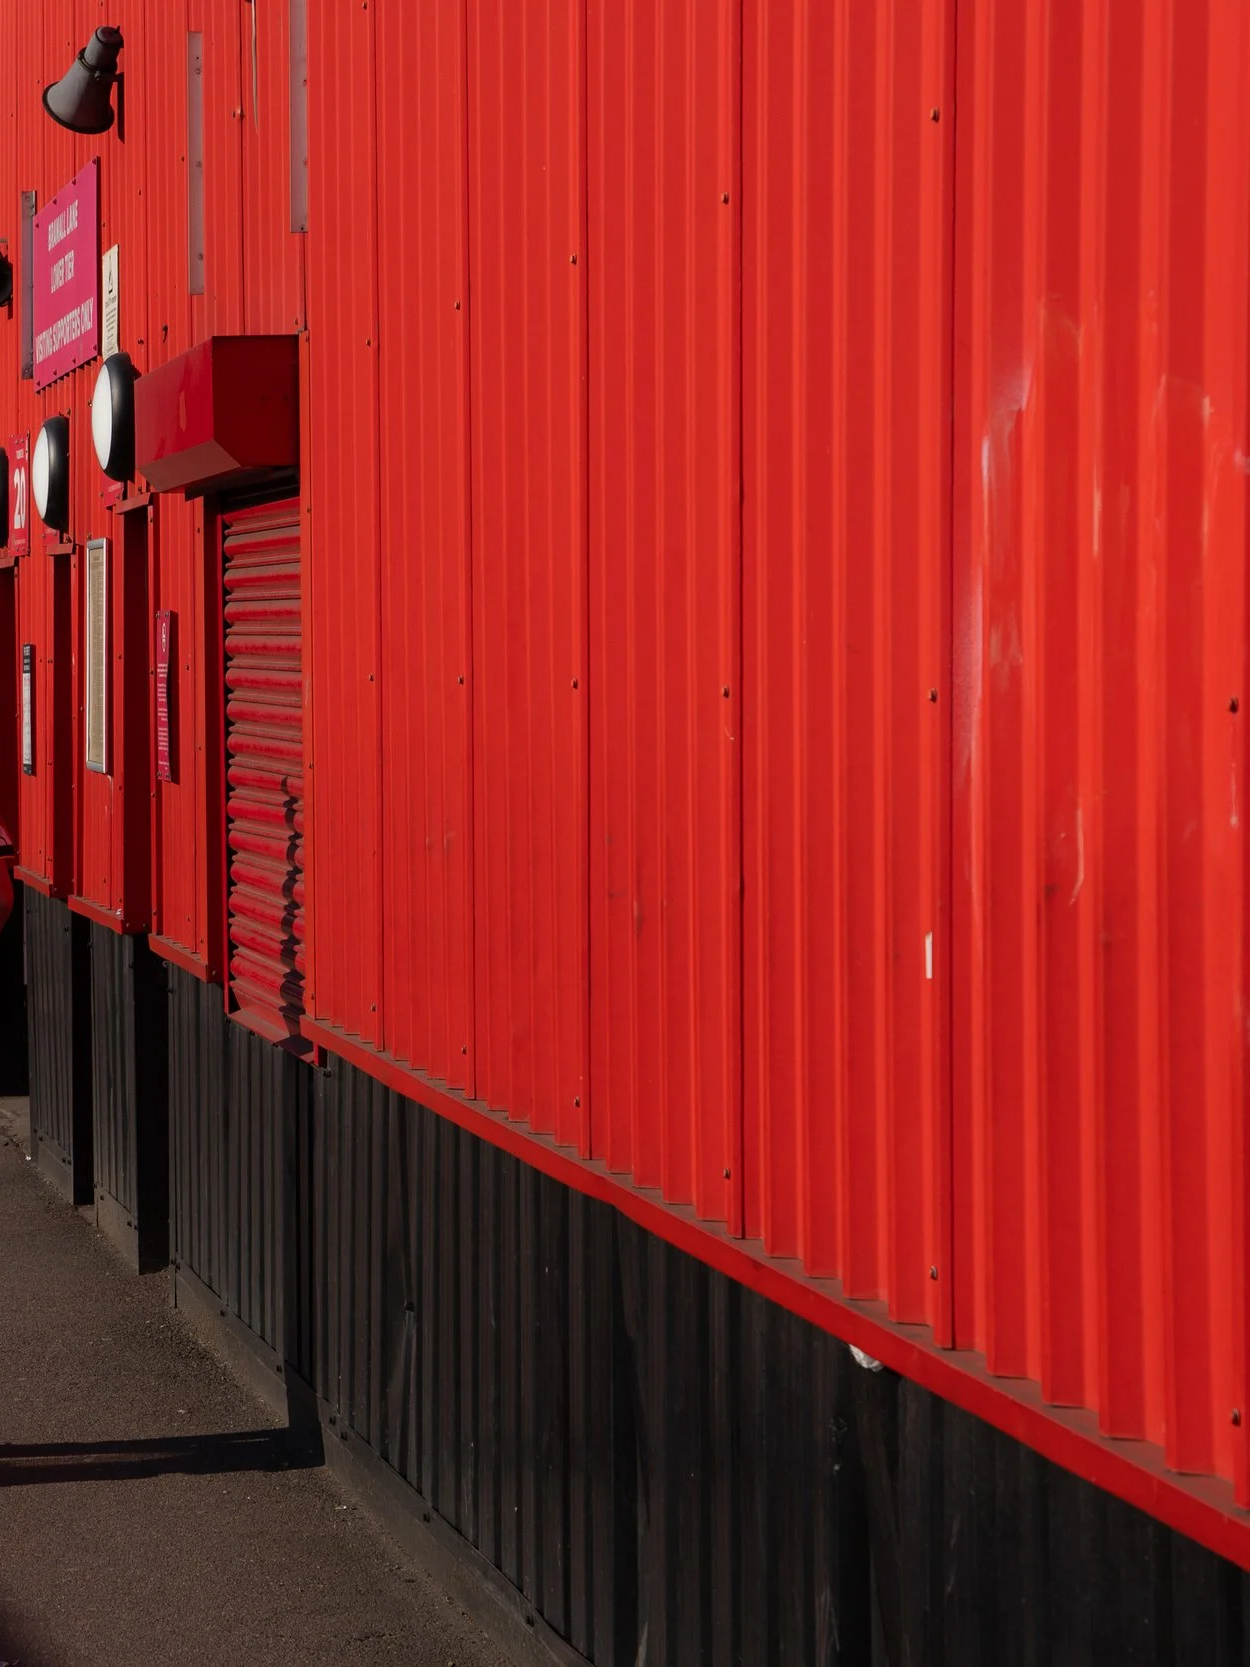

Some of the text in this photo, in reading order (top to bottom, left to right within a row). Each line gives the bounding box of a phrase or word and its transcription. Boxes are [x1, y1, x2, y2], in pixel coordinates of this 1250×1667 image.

[48, 199, 78, 251] BRAMALL LANE
[50, 249, 74, 294] LOWER TIER
[35, 326, 53, 364] VISITING
[52, 306, 80, 354] SUPPORTERS
[80, 297, 94, 335] ONLY
[13, 466, 26, 530] 20
